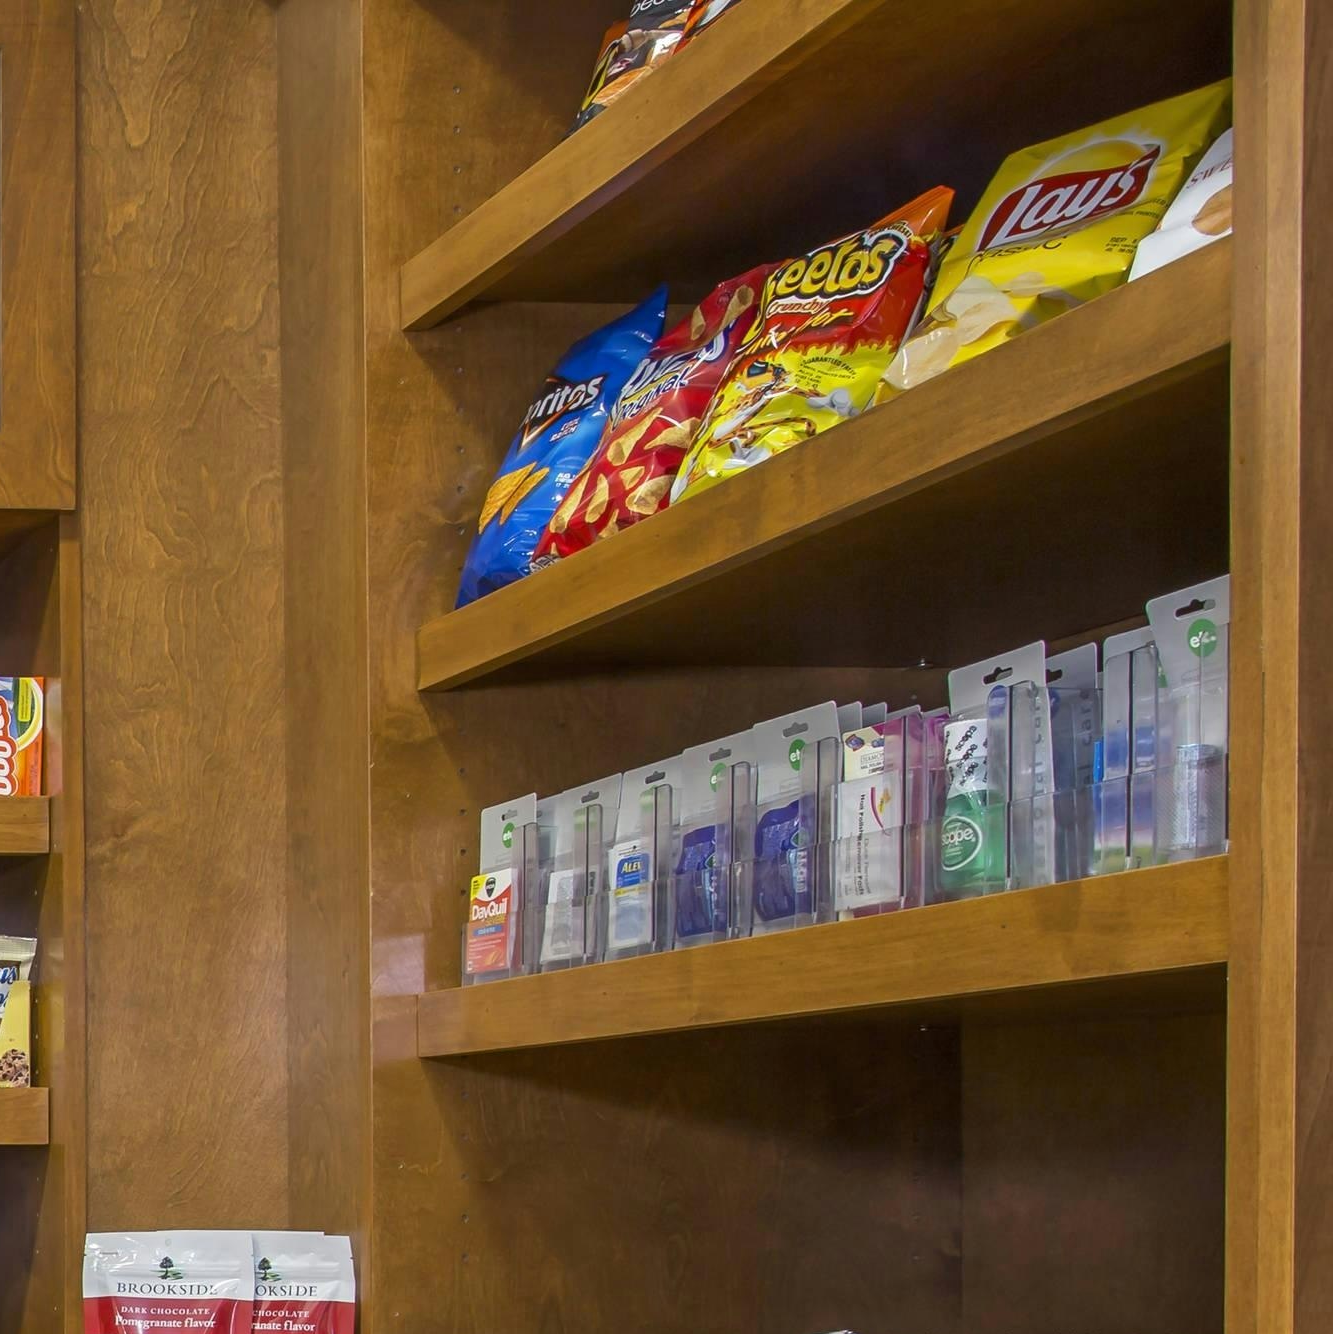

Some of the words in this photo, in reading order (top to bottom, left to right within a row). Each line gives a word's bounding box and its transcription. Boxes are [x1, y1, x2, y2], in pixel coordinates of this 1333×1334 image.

[121, 1306, 148, 1315] DARK
[150, 1307, 210, 1315] CHOCOLATE
[115, 1317, 183, 1331] Pomegranate
[184, 1317, 216, 1329] flavor
[283, 1320, 316, 1332] flavor
